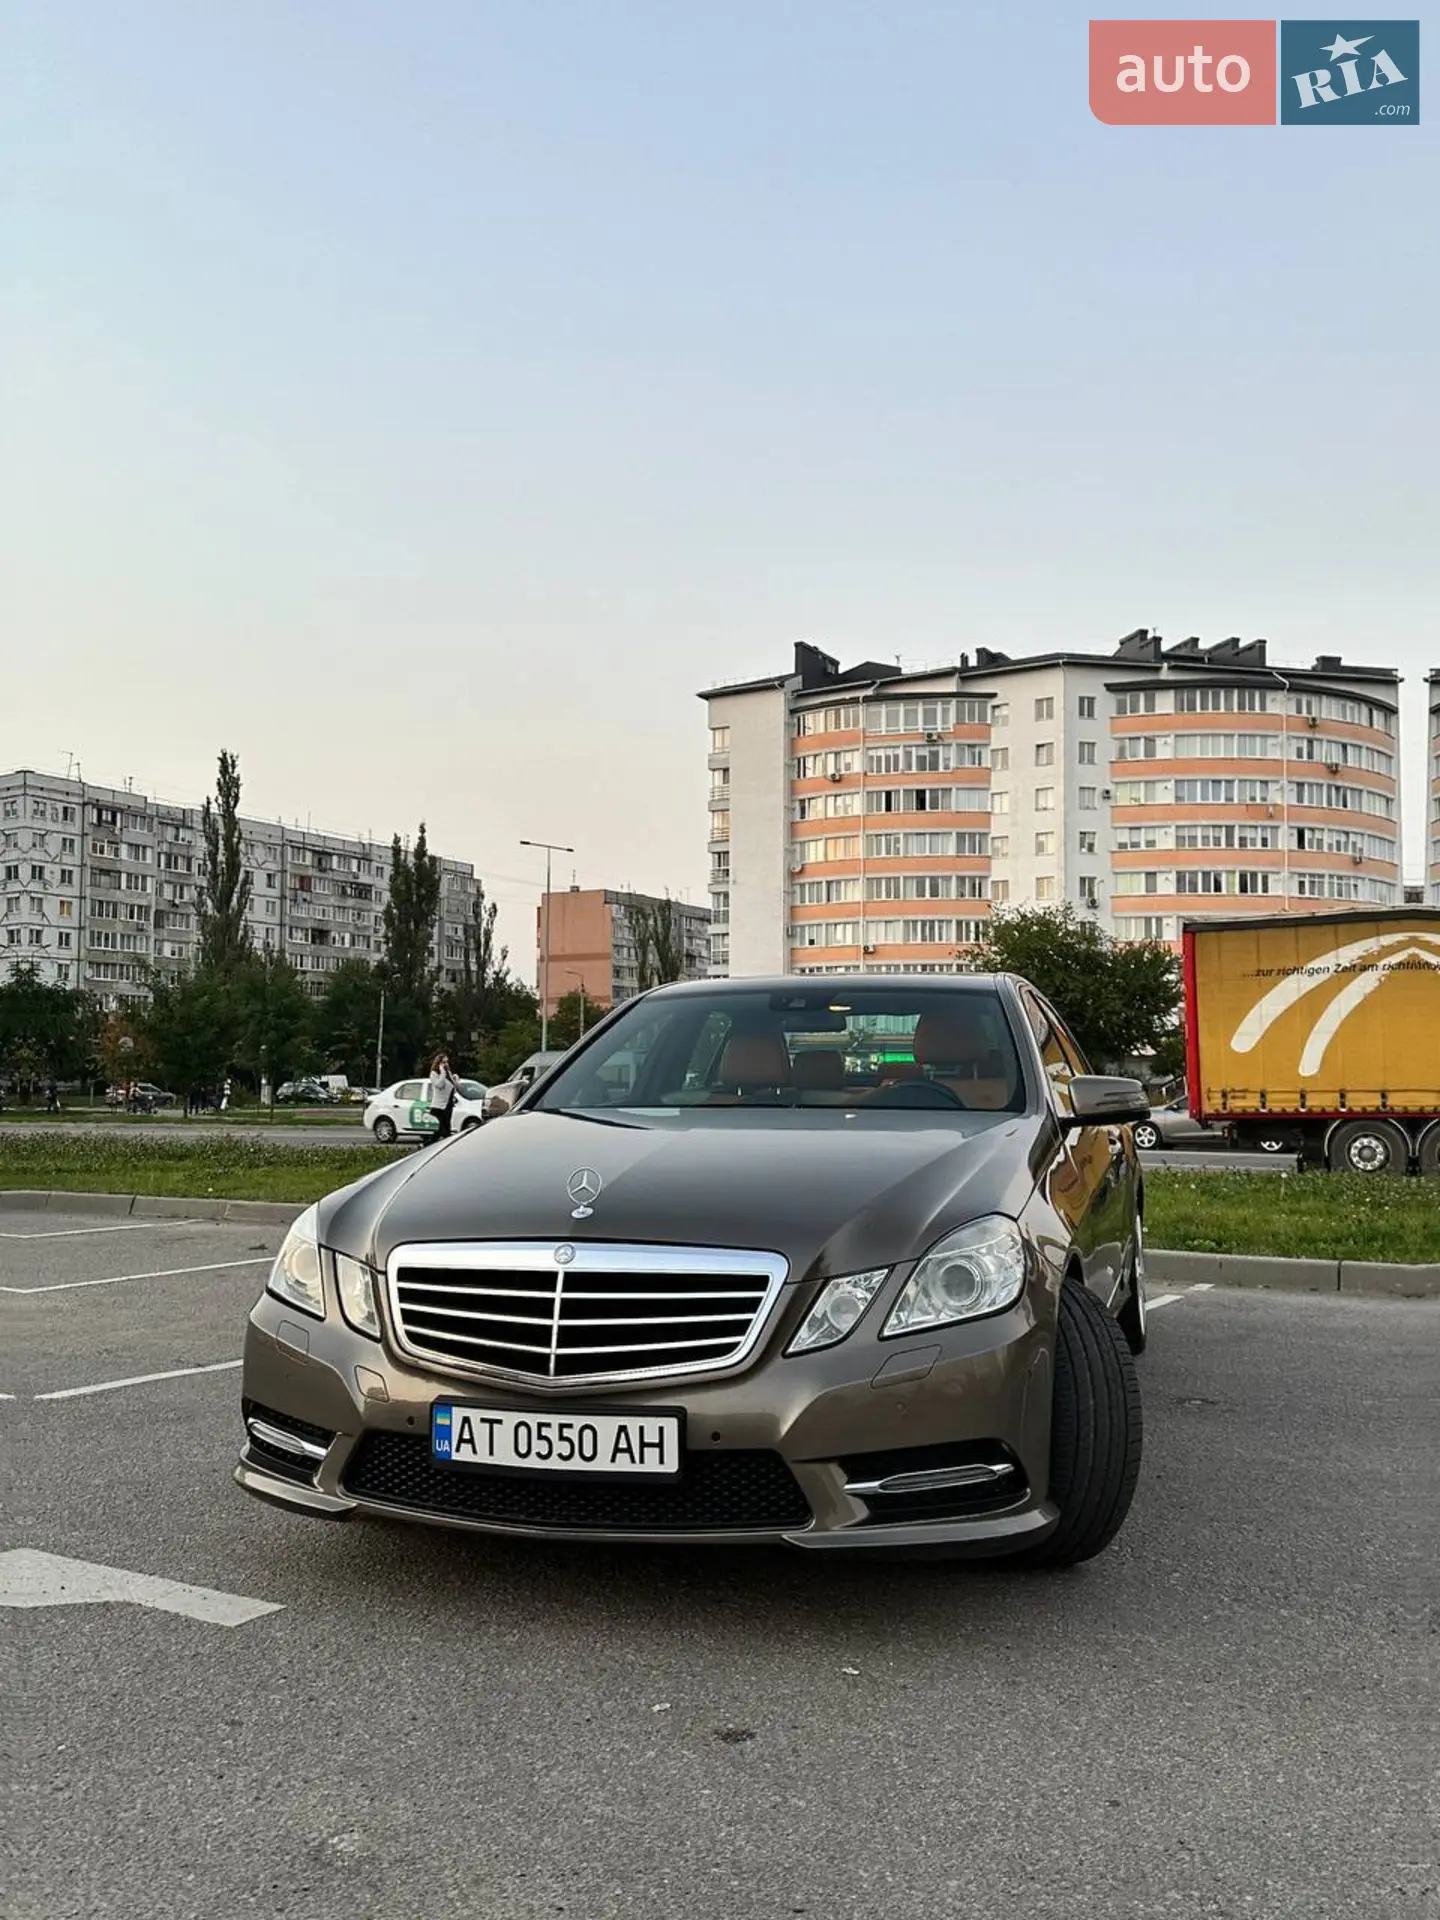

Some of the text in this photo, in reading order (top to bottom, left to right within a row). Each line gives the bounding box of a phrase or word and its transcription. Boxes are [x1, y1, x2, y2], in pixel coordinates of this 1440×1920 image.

[1277, 965, 1330, 978] richtigen
[1333, 963, 1357, 974] Zeit
[436, 1439, 450, 1452] UA
[455, 1416, 665, 1465] AT 0550 AH
